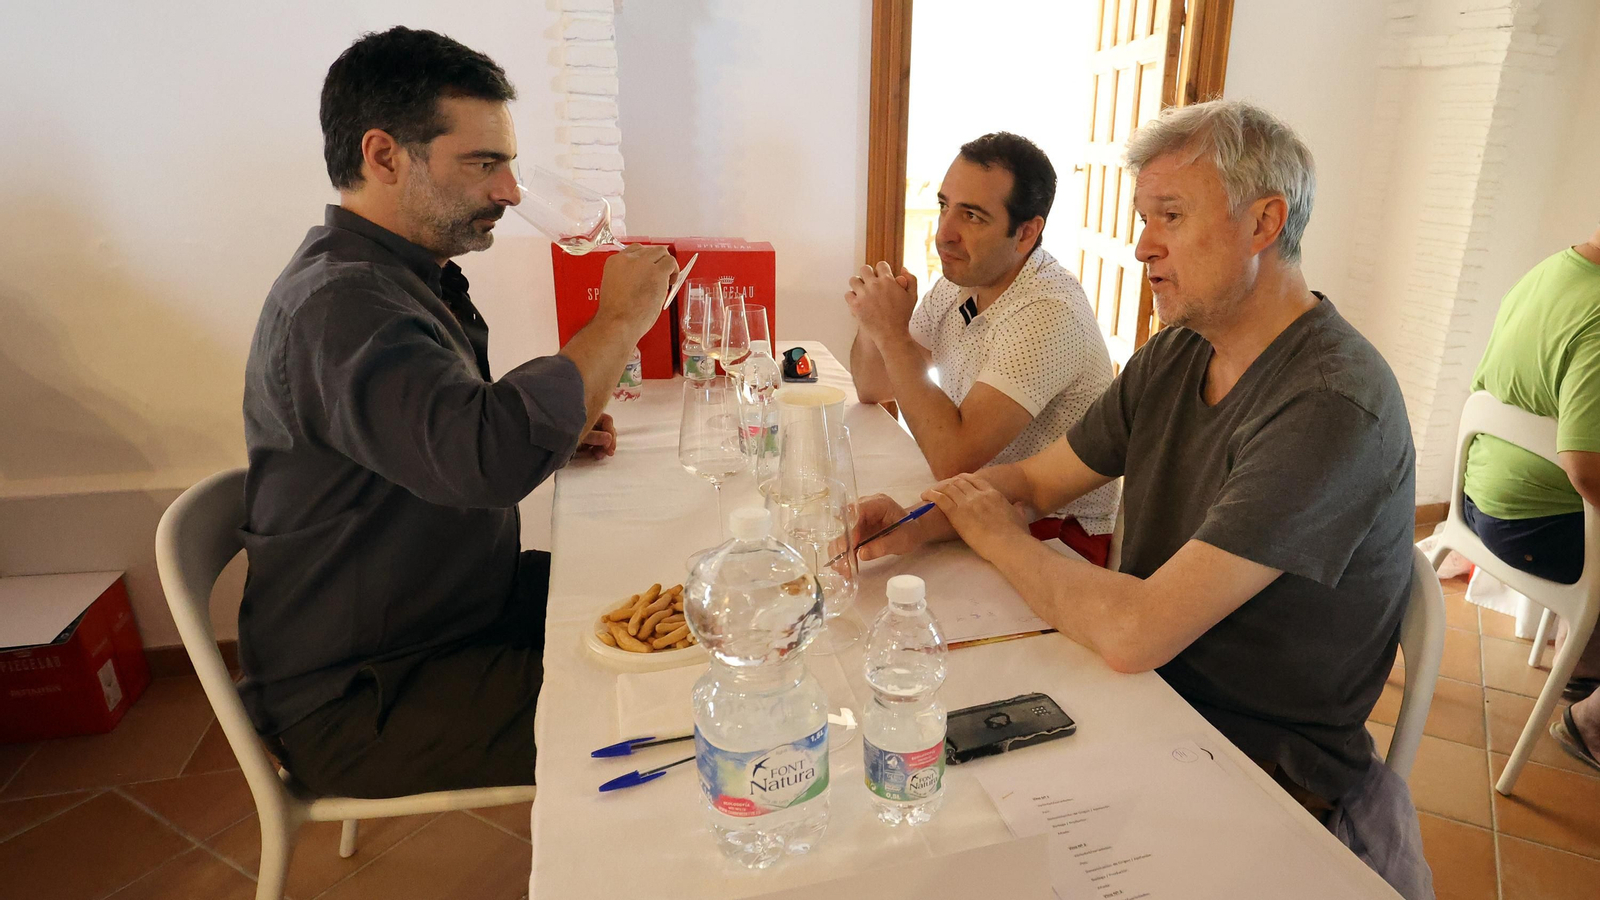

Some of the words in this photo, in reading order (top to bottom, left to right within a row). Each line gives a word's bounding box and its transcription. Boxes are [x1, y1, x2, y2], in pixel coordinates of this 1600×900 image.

[0, 656, 61, 673] PIEGELAU
[770, 760, 805, 778] FONT
[749, 765, 816, 796] Natura
[909, 777, 938, 791] Natura
[919, 773, 935, 784] FONT
